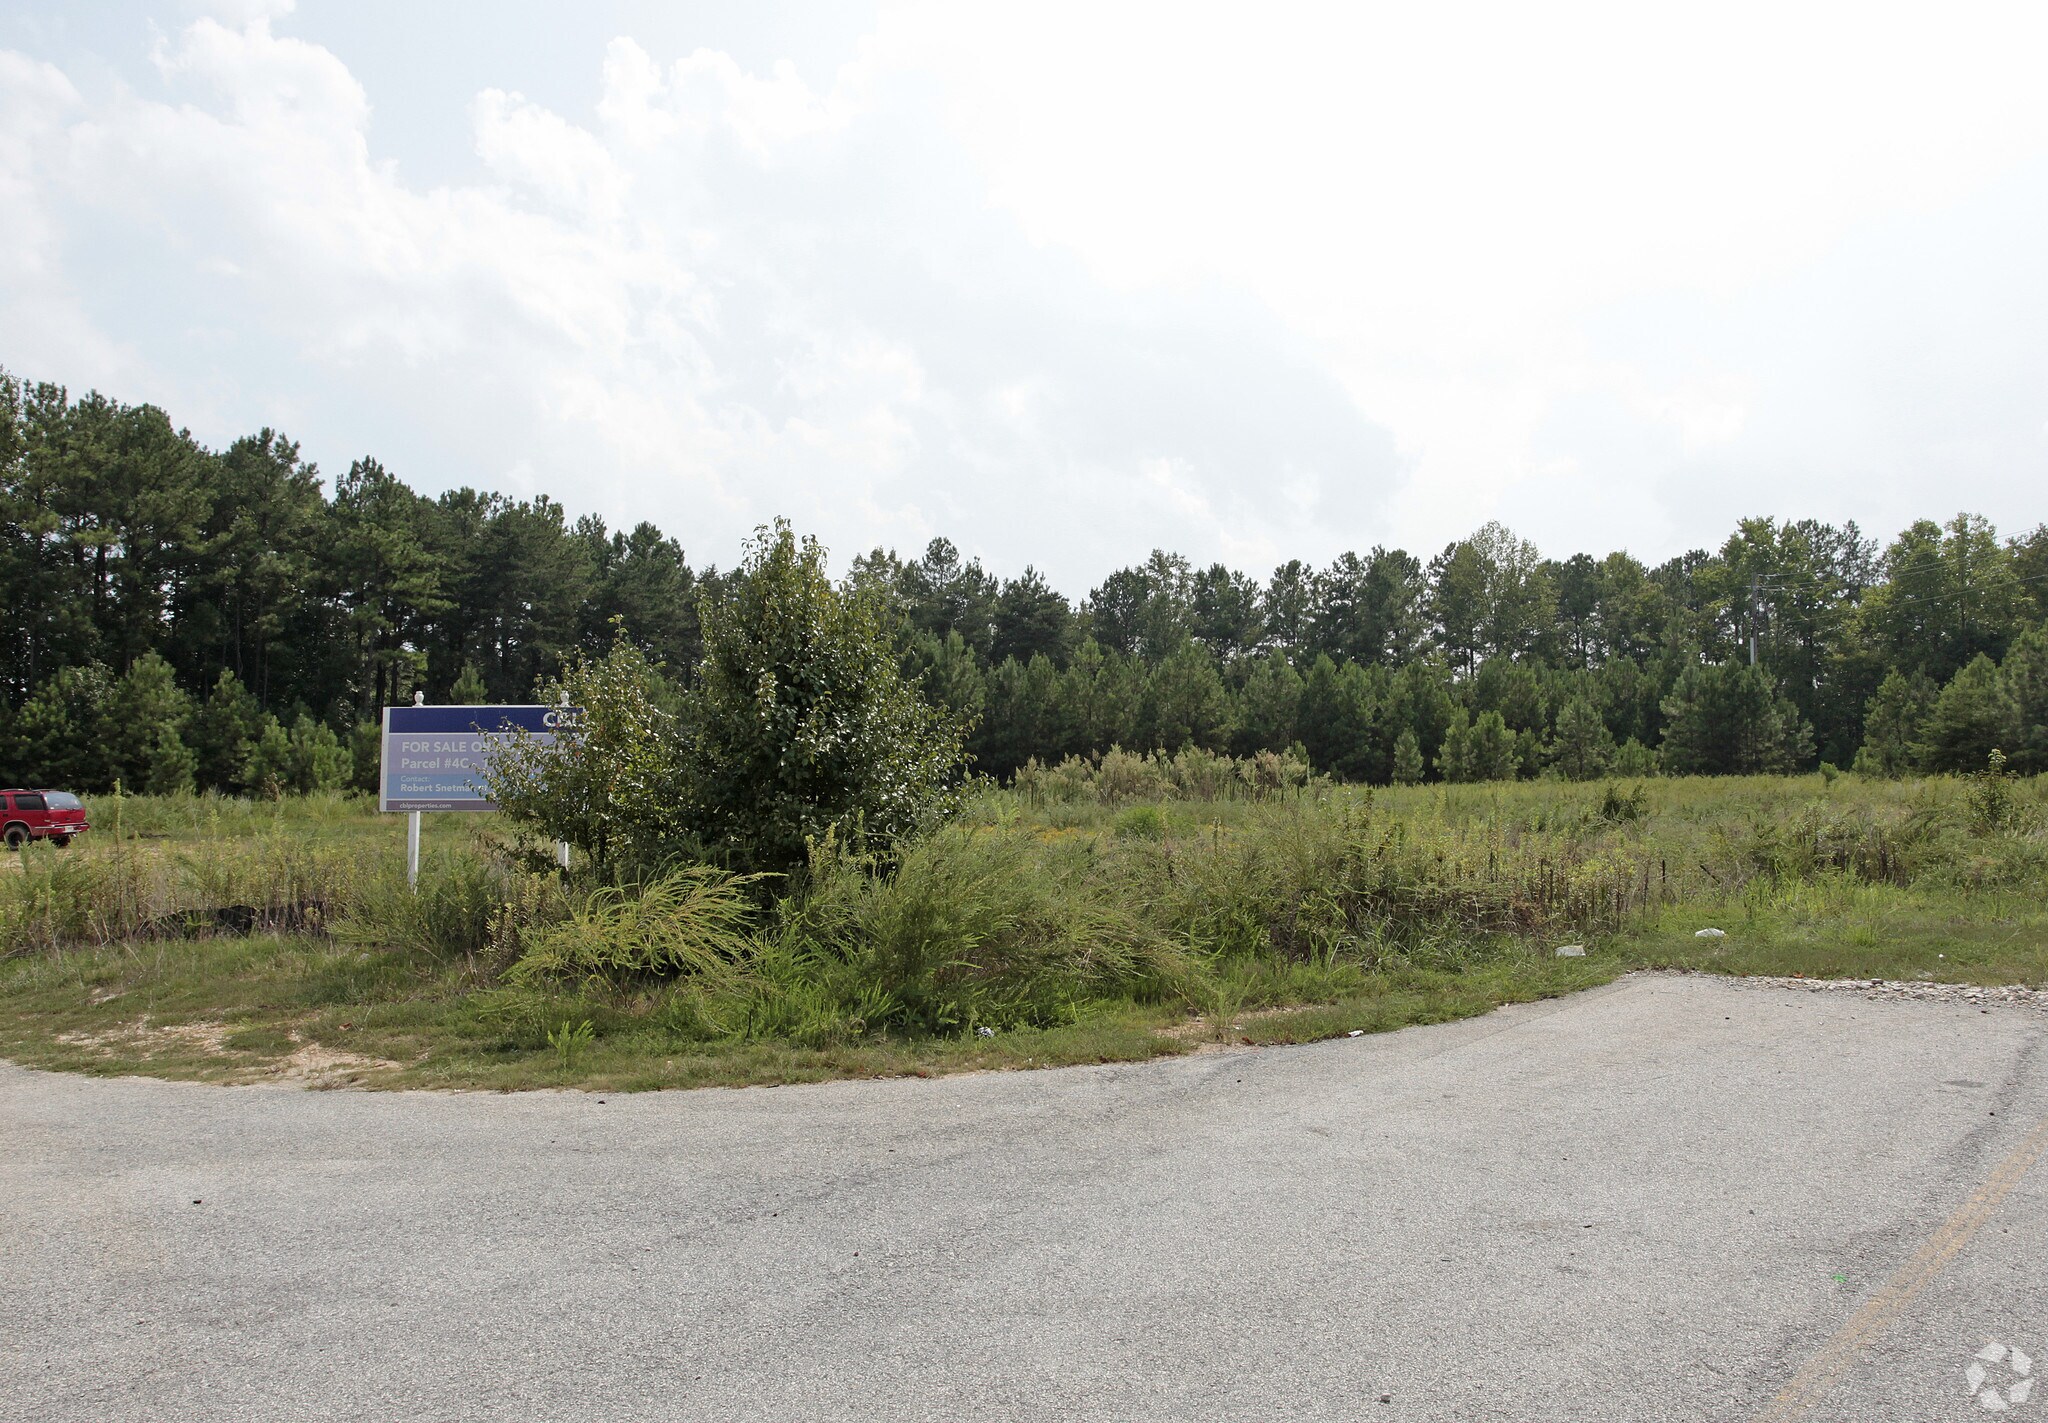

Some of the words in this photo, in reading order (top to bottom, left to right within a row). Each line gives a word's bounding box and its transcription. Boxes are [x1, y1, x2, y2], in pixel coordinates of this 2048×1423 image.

[402, 741, 429, 752] FOR
[433, 741, 467, 752] SALE
[471, 741, 491, 752] OR
[401, 758, 440, 769] Parcel
[444, 758, 469, 769] #4C
[400, 784, 432, 792] Robert
